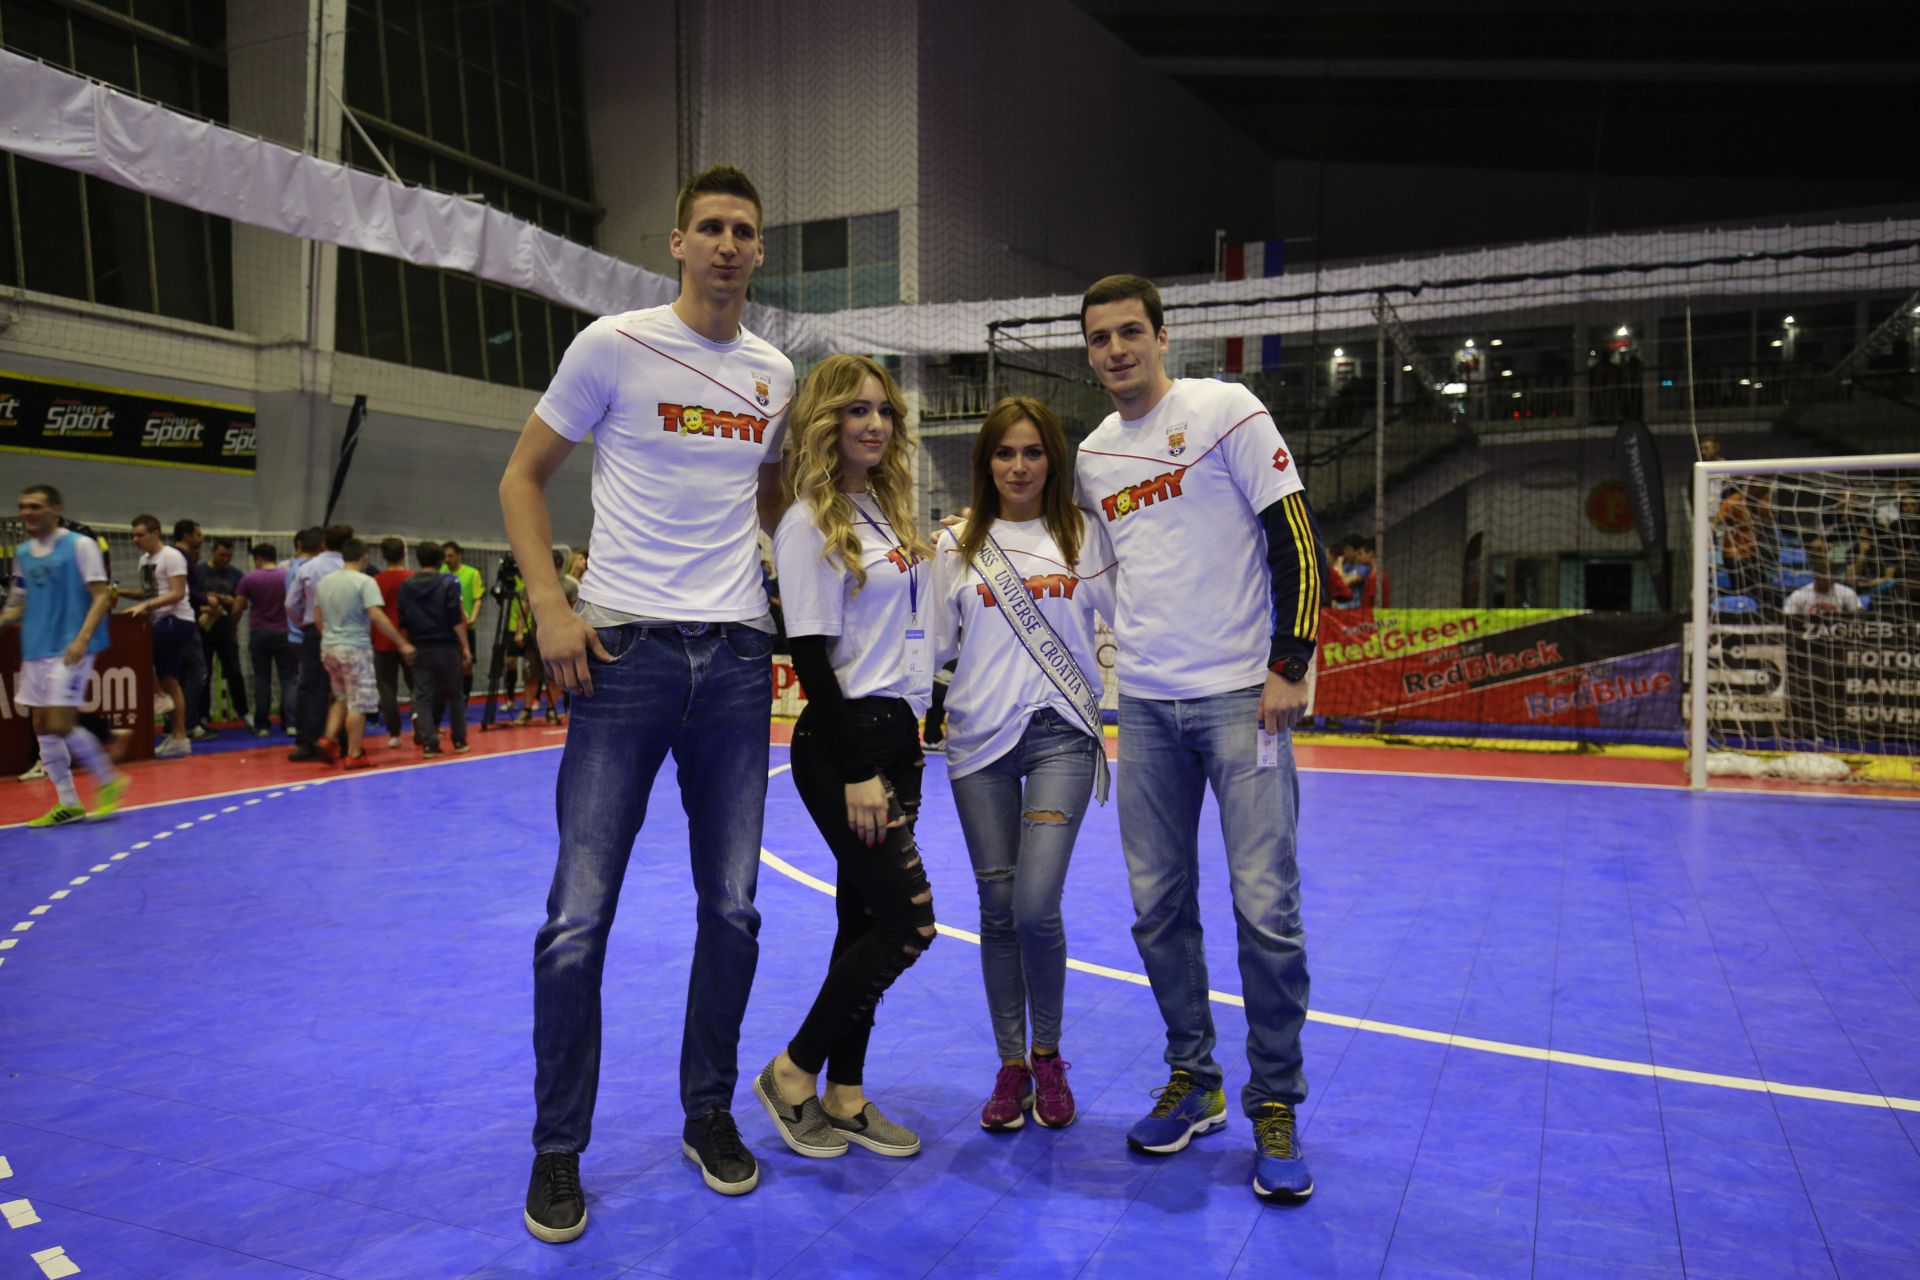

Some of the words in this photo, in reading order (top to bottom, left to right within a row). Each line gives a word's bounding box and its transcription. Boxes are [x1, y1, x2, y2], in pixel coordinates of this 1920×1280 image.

[44, 406, 114, 436] Sport
[142, 418, 205, 447] Sport
[658, 402, 769, 444] TOMMY
[1101, 467, 1187, 522] TOMMY
[995, 570, 1041, 635] UNIVERSE
[1039, 640, 1082, 695] CROATIA
[1323, 616, 1479, 667] RedGreen
[1403, 640, 1563, 696] RedBlack
[1525, 672, 1673, 720] RedBlue
